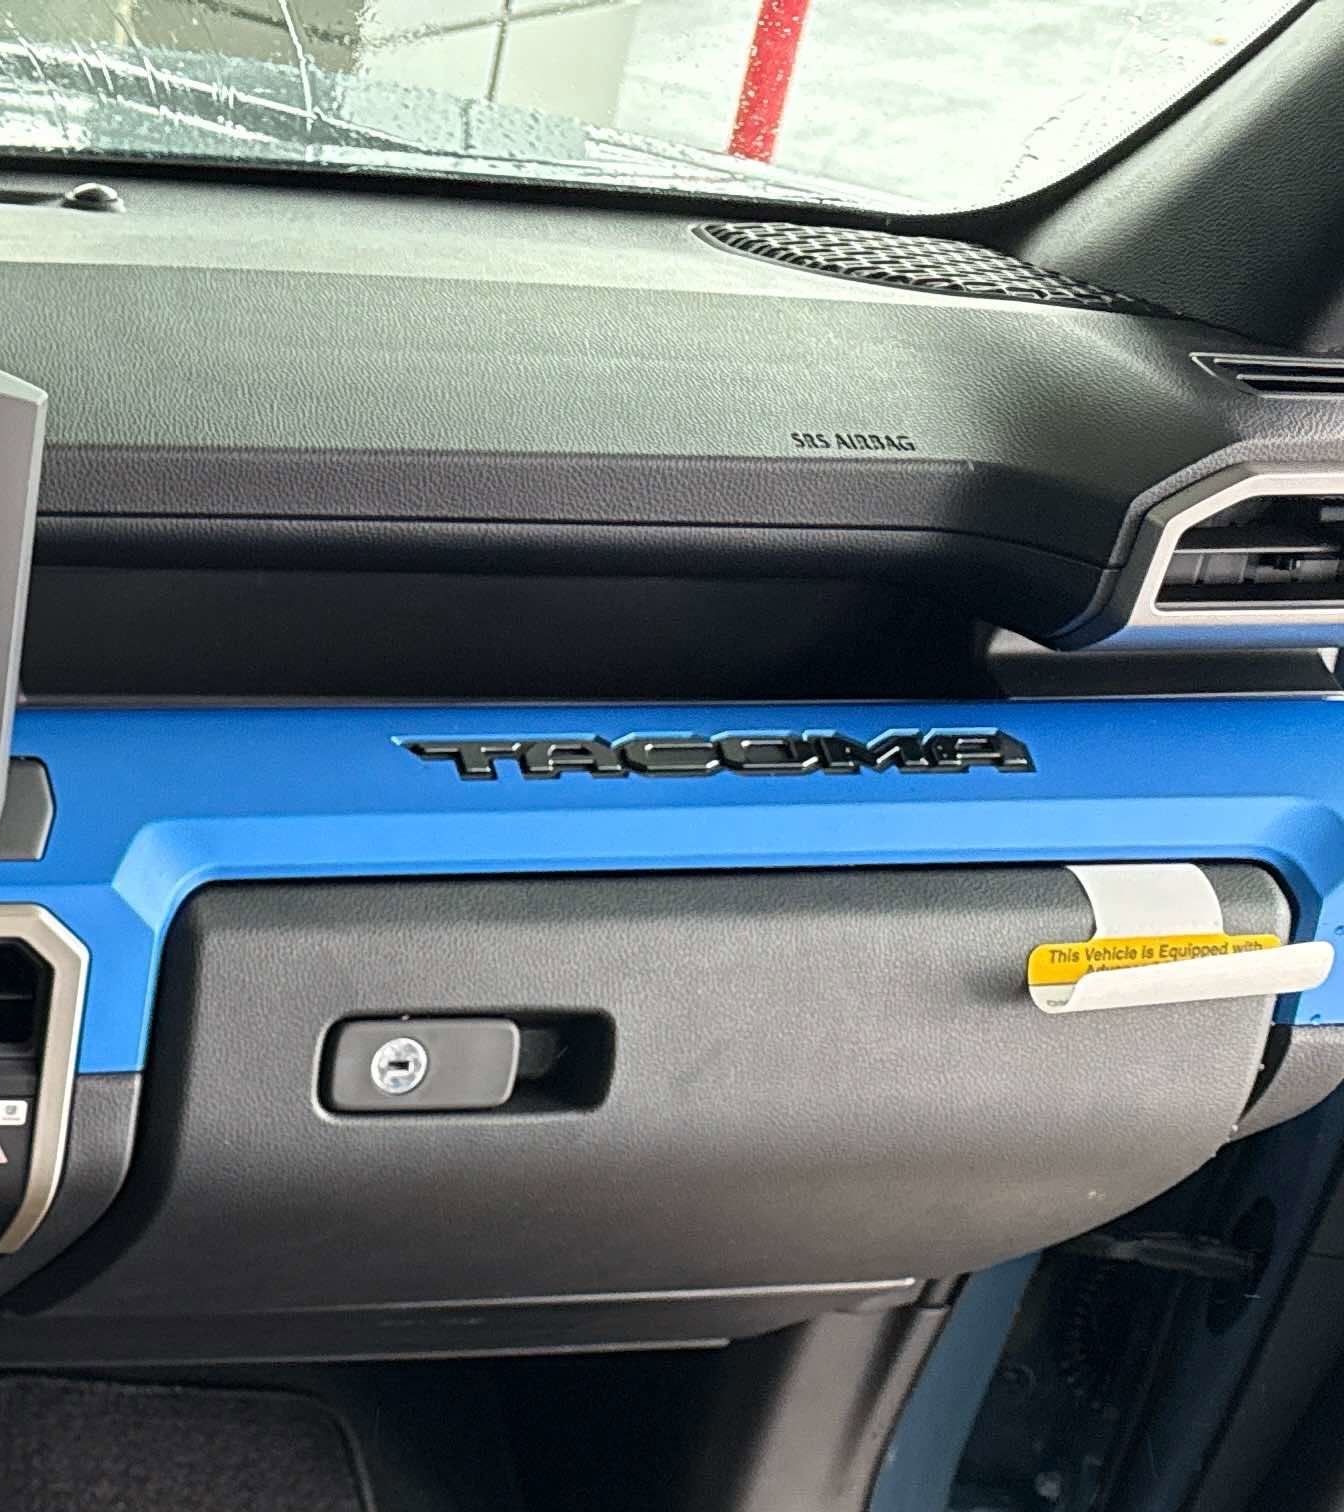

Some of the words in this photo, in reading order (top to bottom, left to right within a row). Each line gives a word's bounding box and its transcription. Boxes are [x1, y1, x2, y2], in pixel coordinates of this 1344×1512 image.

[790, 432, 831, 449] SRS
[834, 432, 916, 451] AIRBAG
[391, 728, 1037, 780] TACOMA
[1048, 948, 1081, 964] This
[1085, 945, 1138, 962] Vehicle
[1159, 941, 1229, 961] Equipped
